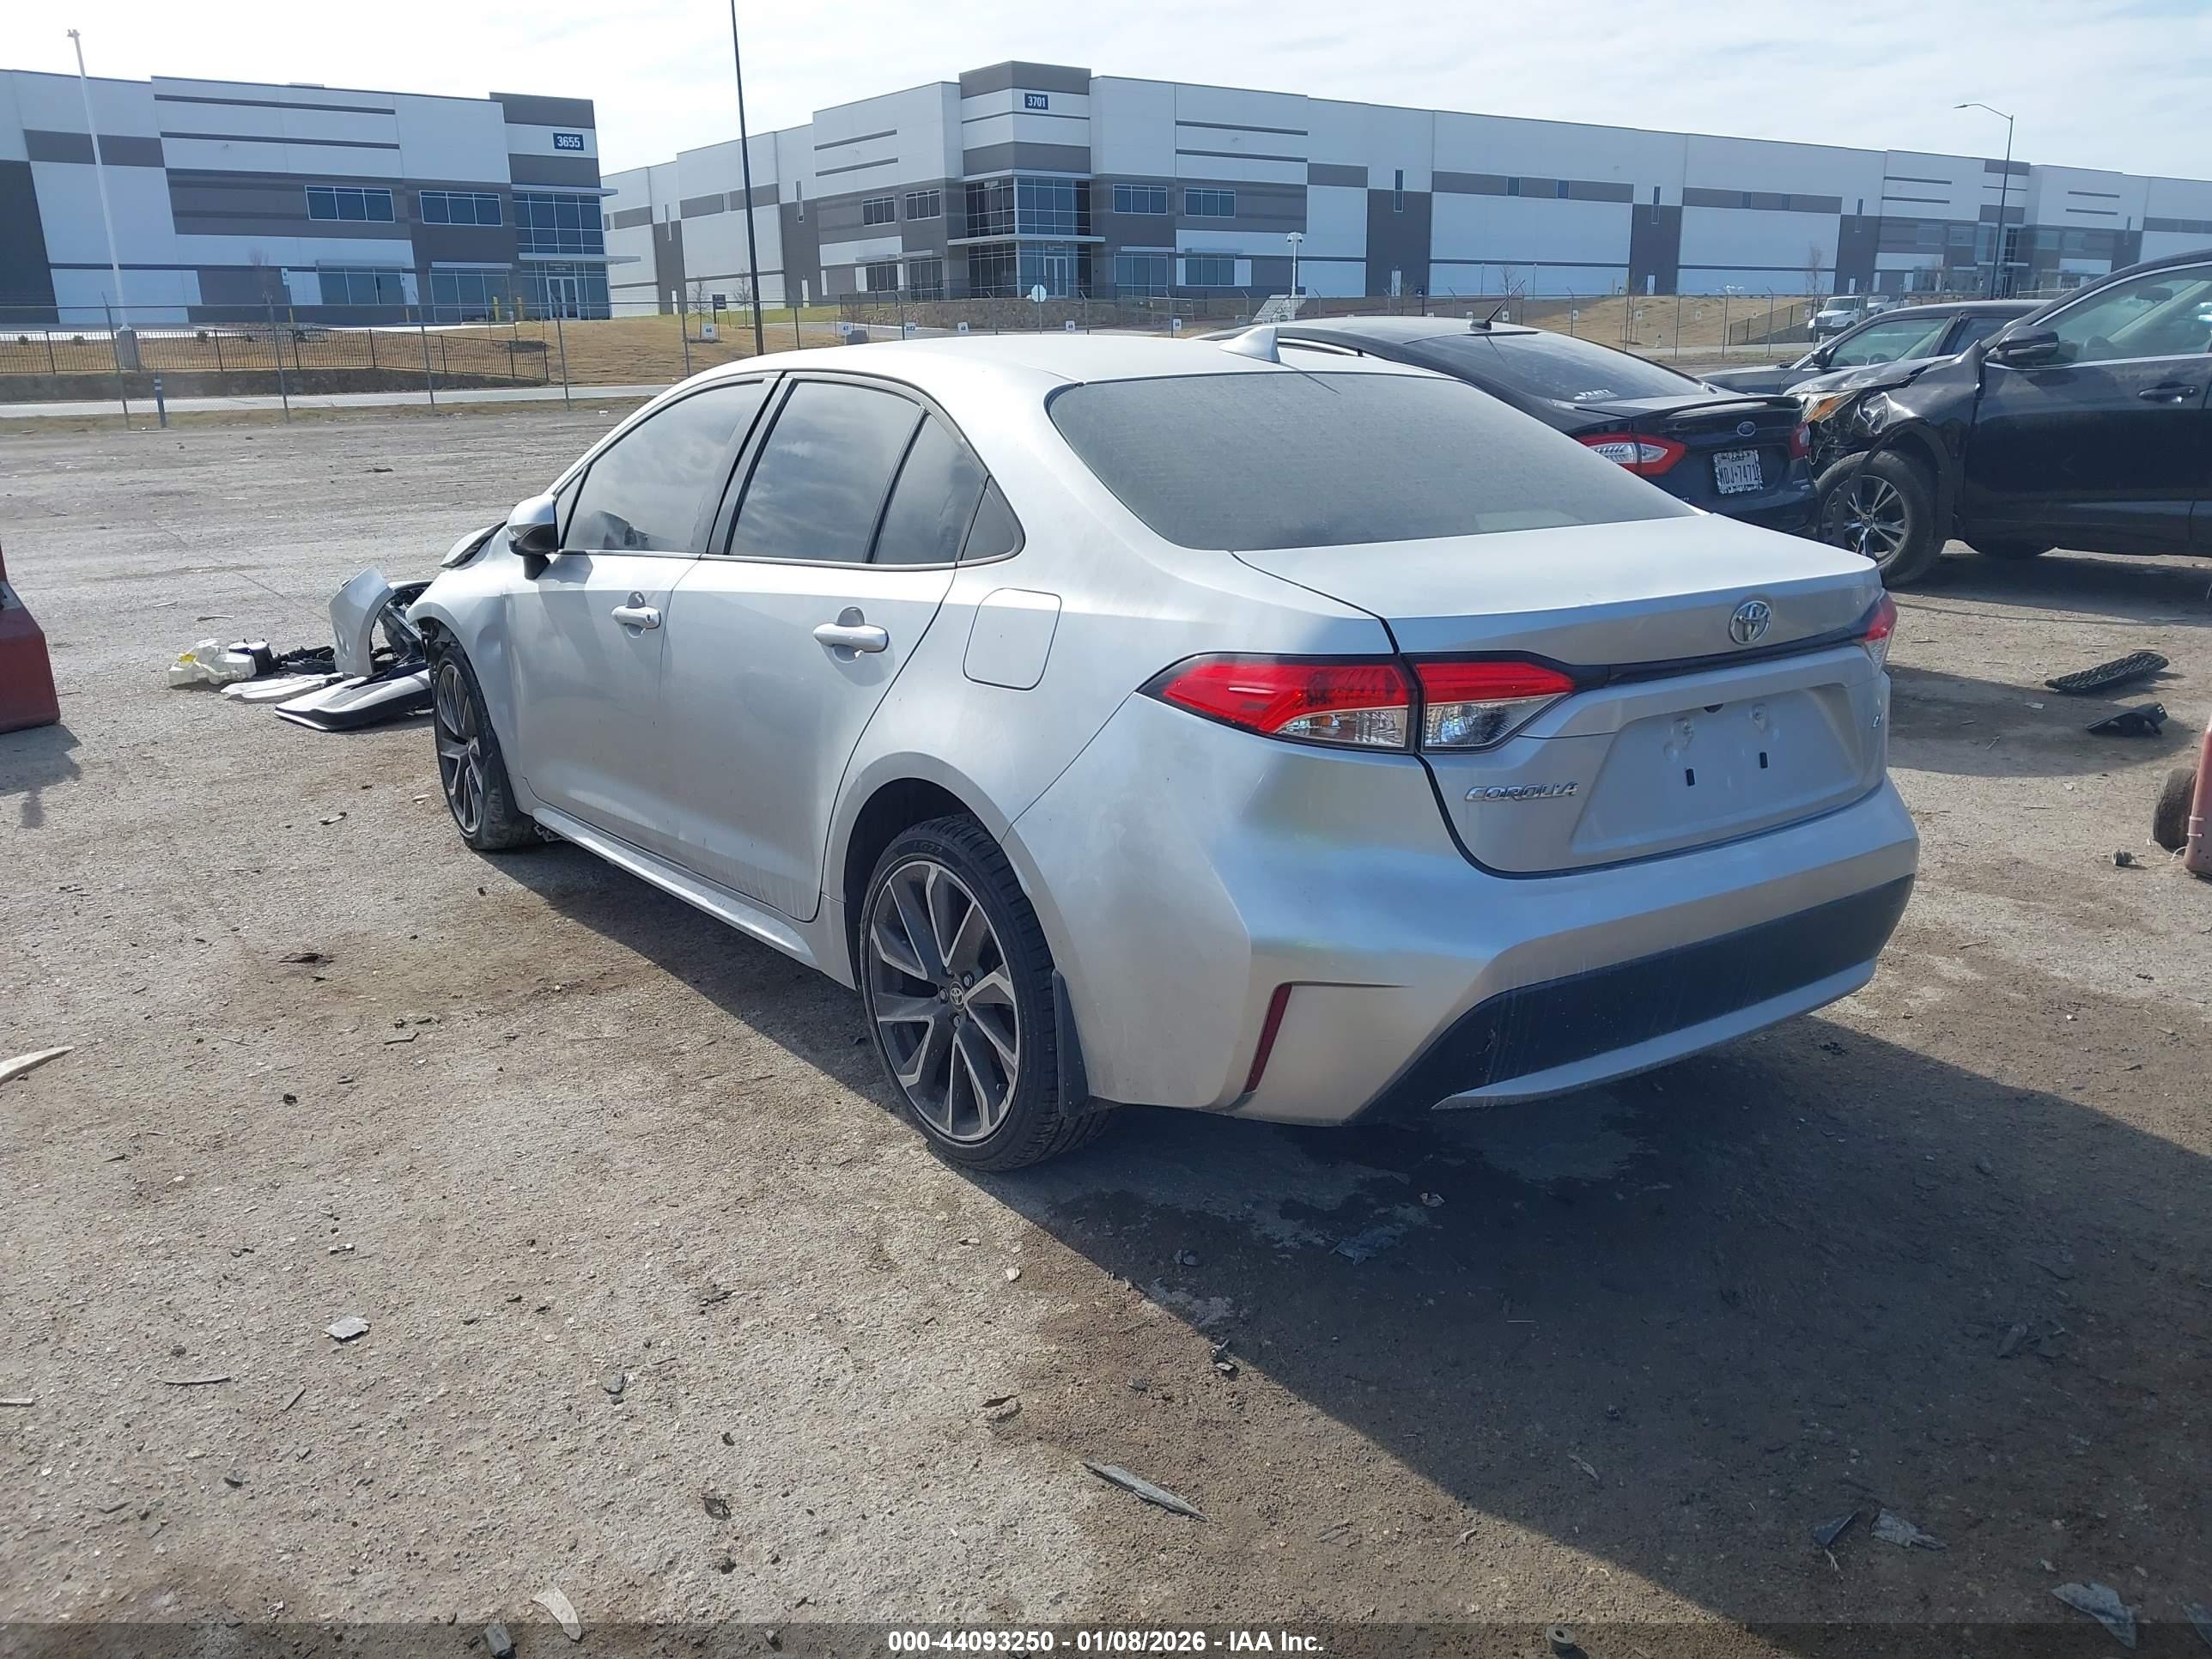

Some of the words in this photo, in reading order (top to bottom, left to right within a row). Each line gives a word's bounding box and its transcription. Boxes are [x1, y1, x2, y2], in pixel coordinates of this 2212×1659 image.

[1028, 96, 1046, 107] 3701
[556, 136, 580, 148] 3655
[1464, 781, 1579, 801] COROLLA
